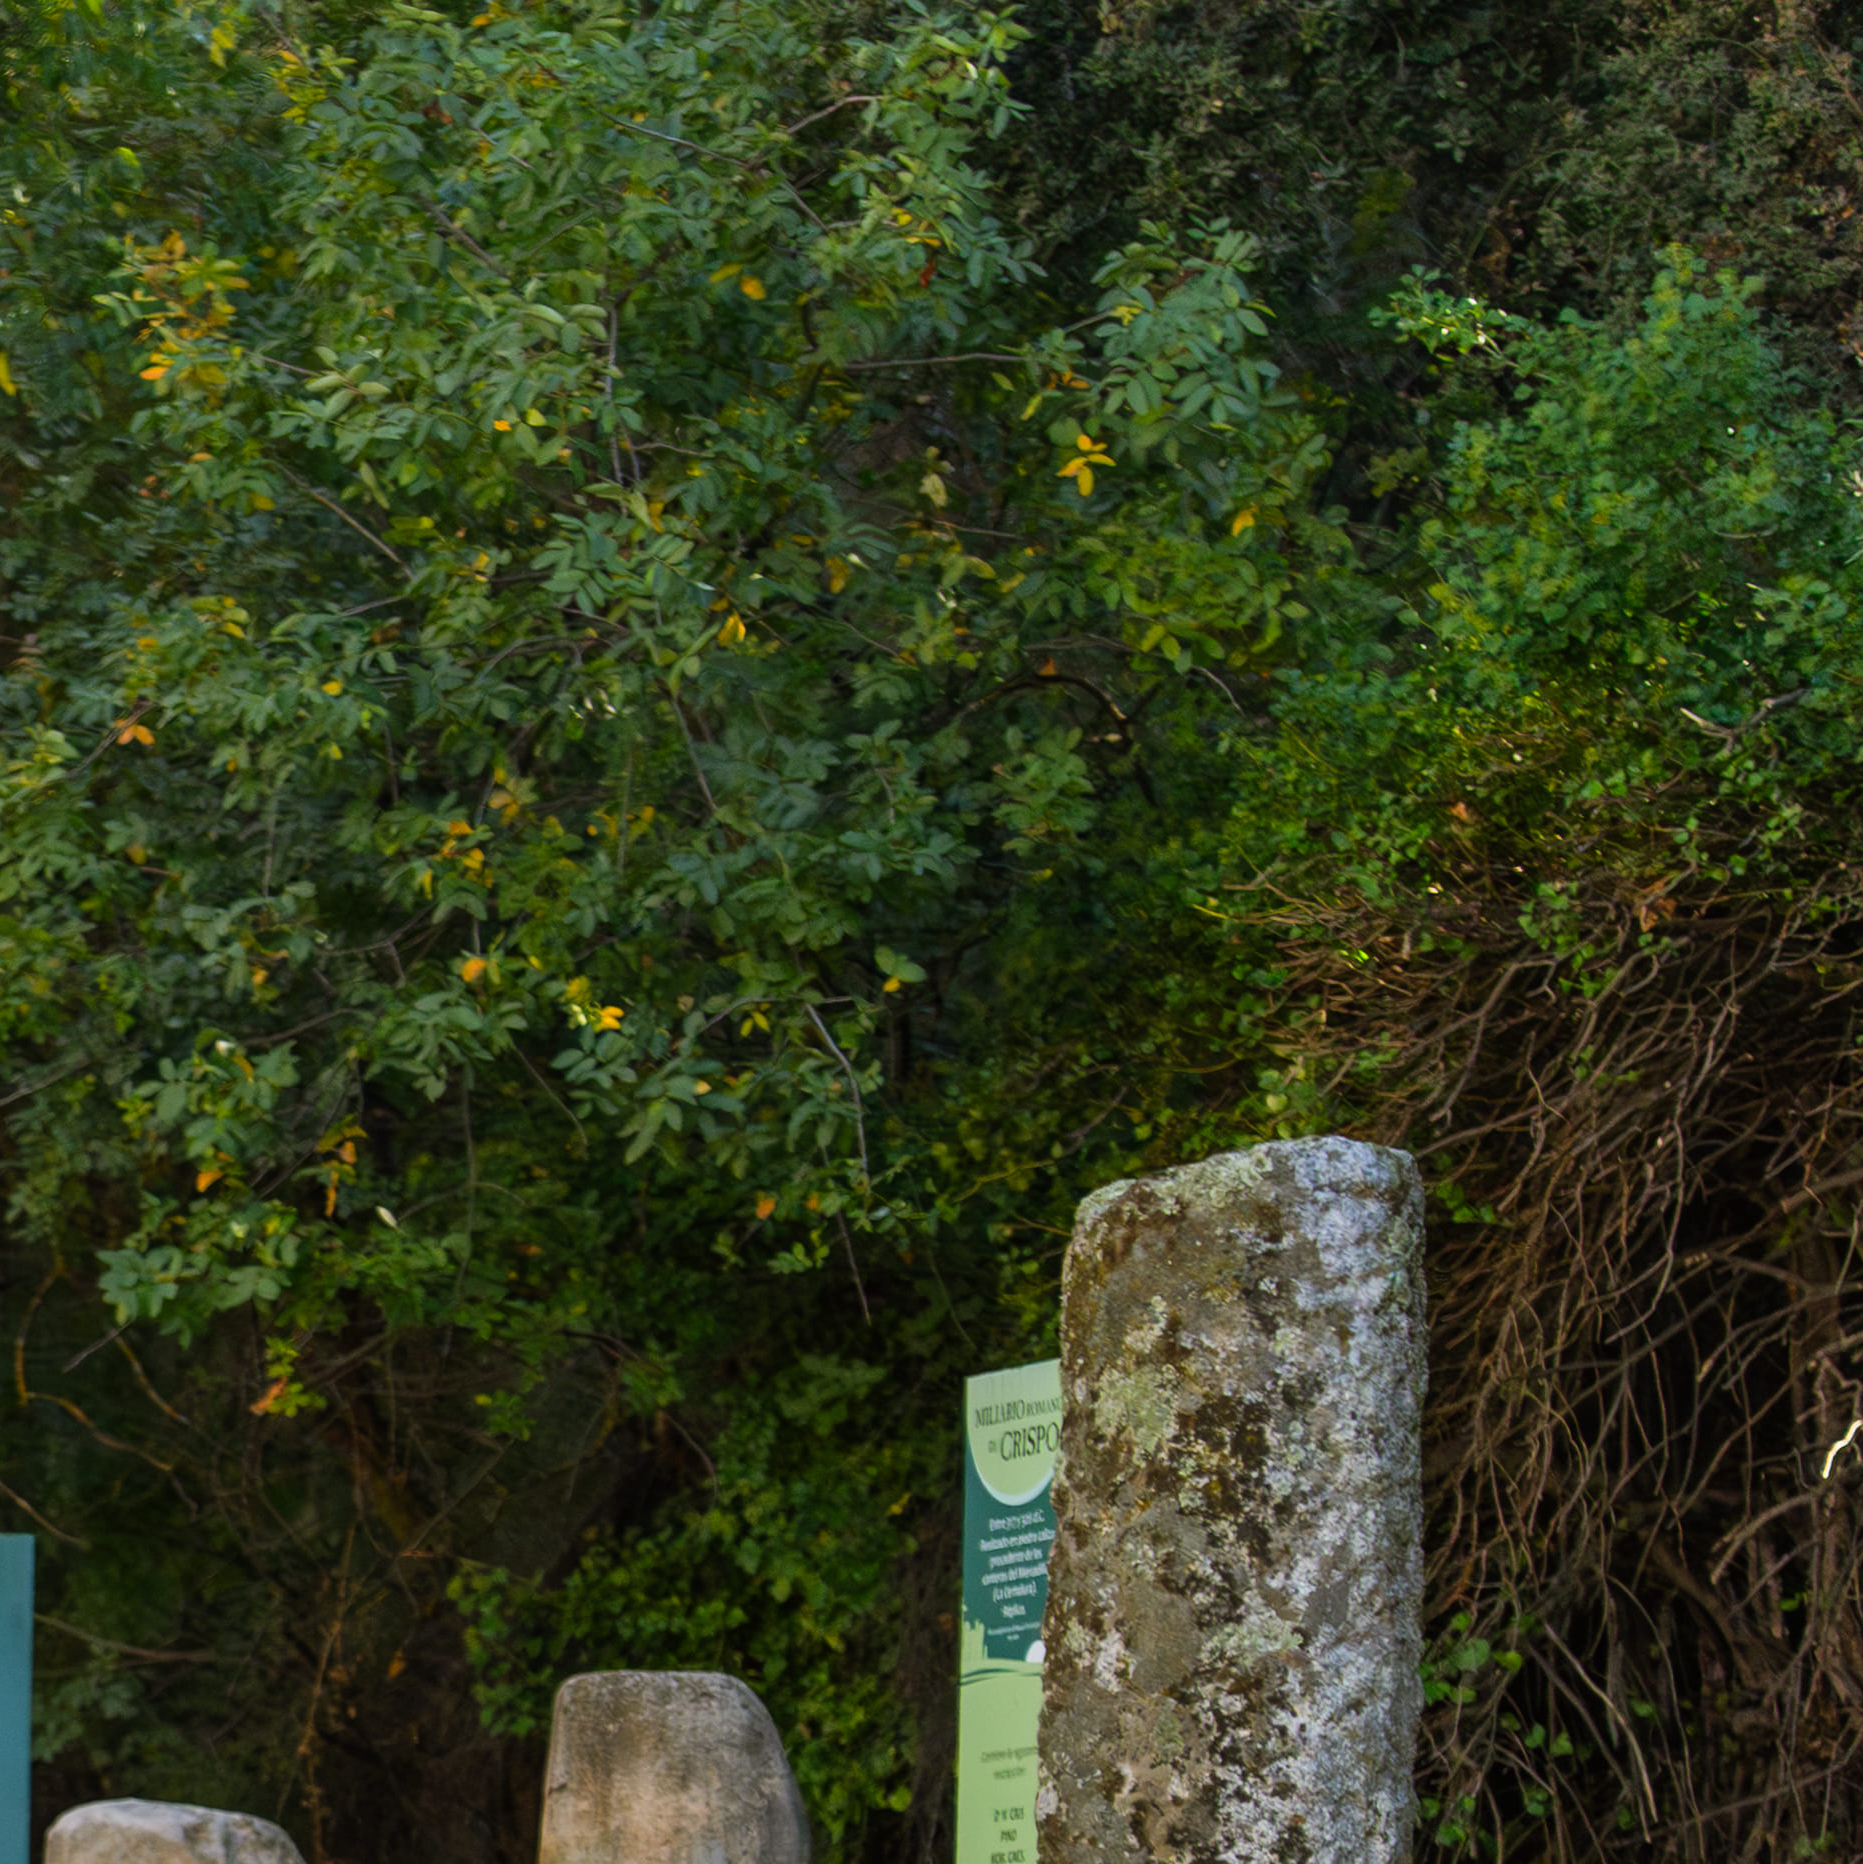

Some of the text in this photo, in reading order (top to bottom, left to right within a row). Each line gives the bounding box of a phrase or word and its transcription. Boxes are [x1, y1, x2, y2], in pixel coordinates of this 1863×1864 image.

[976, 1397, 1061, 1428] MILIARIO ROMAN
[1001, 1422, 1060, 1461] CRISPO
